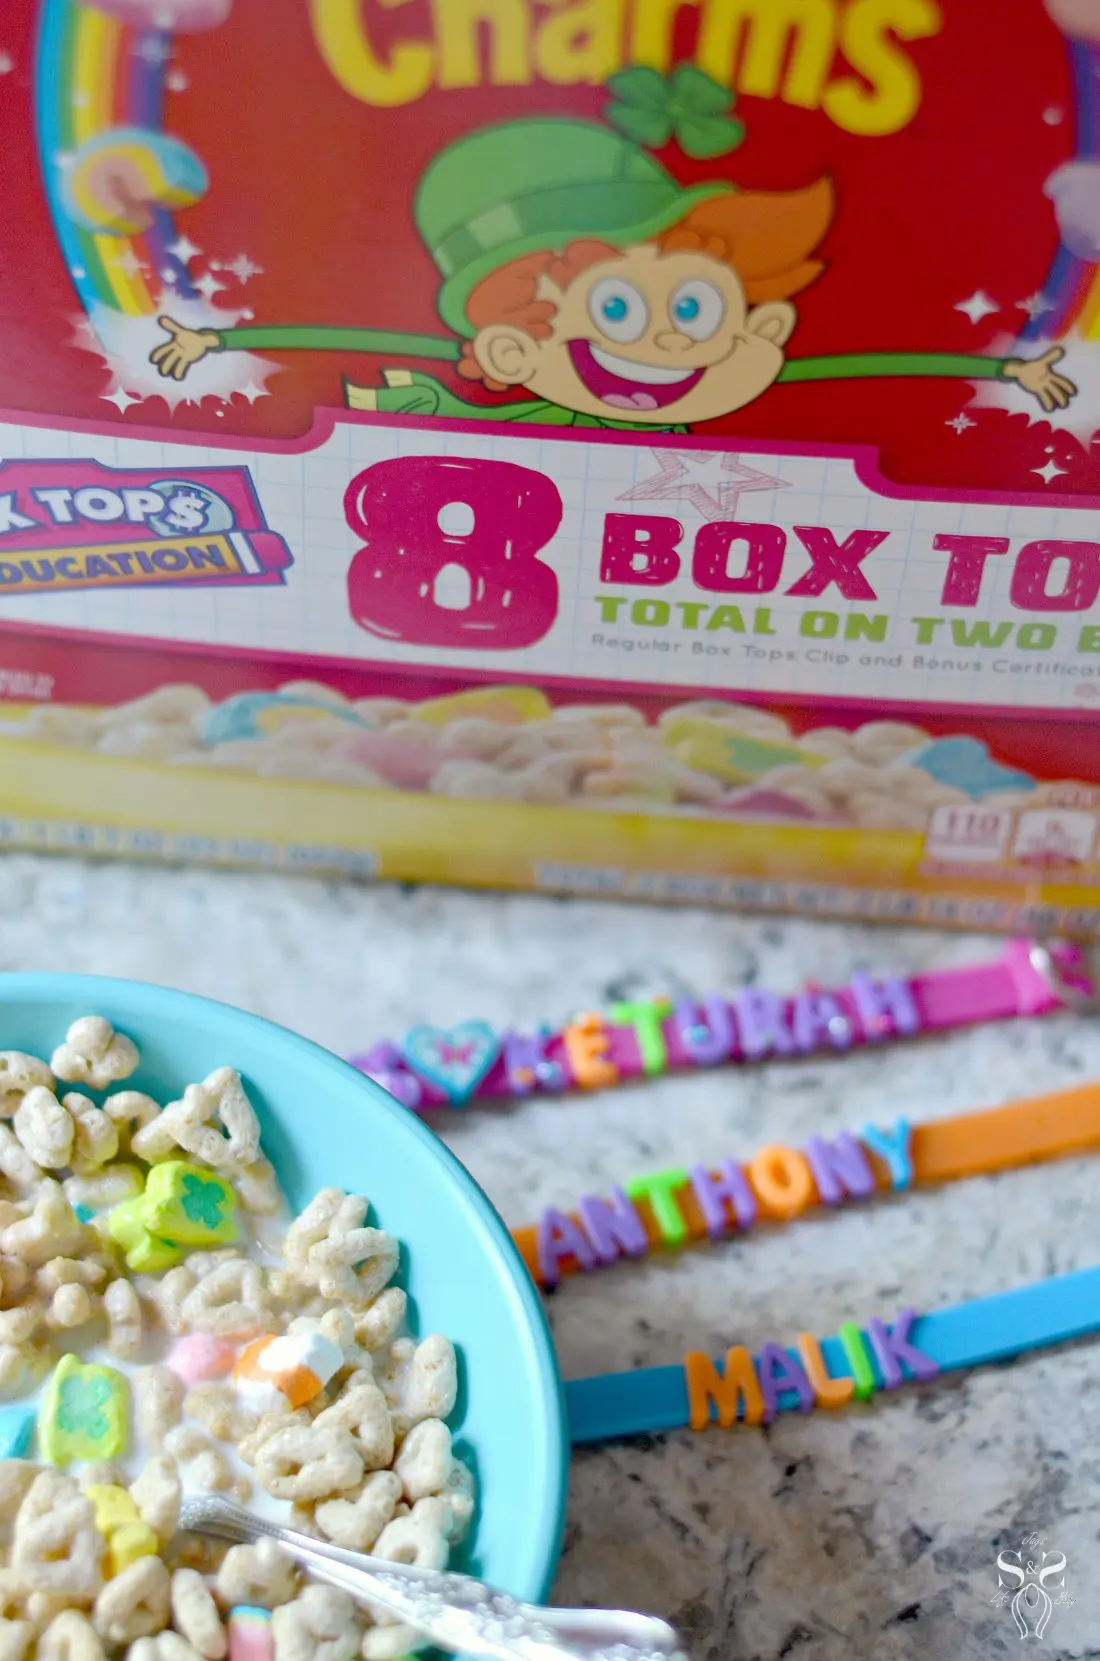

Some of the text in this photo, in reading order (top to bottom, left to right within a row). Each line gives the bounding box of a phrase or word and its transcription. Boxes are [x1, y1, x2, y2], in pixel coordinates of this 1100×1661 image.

[343, 455, 563, 650] 8
[600, 512, 1100, 612] BOX TO
[591, 632, 1100, 678] Regular Box Tops Clip and Bonus Certifica
[594, 595, 778, 635] TOTAL
[798, 609, 889, 643] ON
[911, 616, 1057, 651] TWO
[536, 1115, 913, 1285] ANTHONY
[683, 1307, 941, 1432] MALIK
